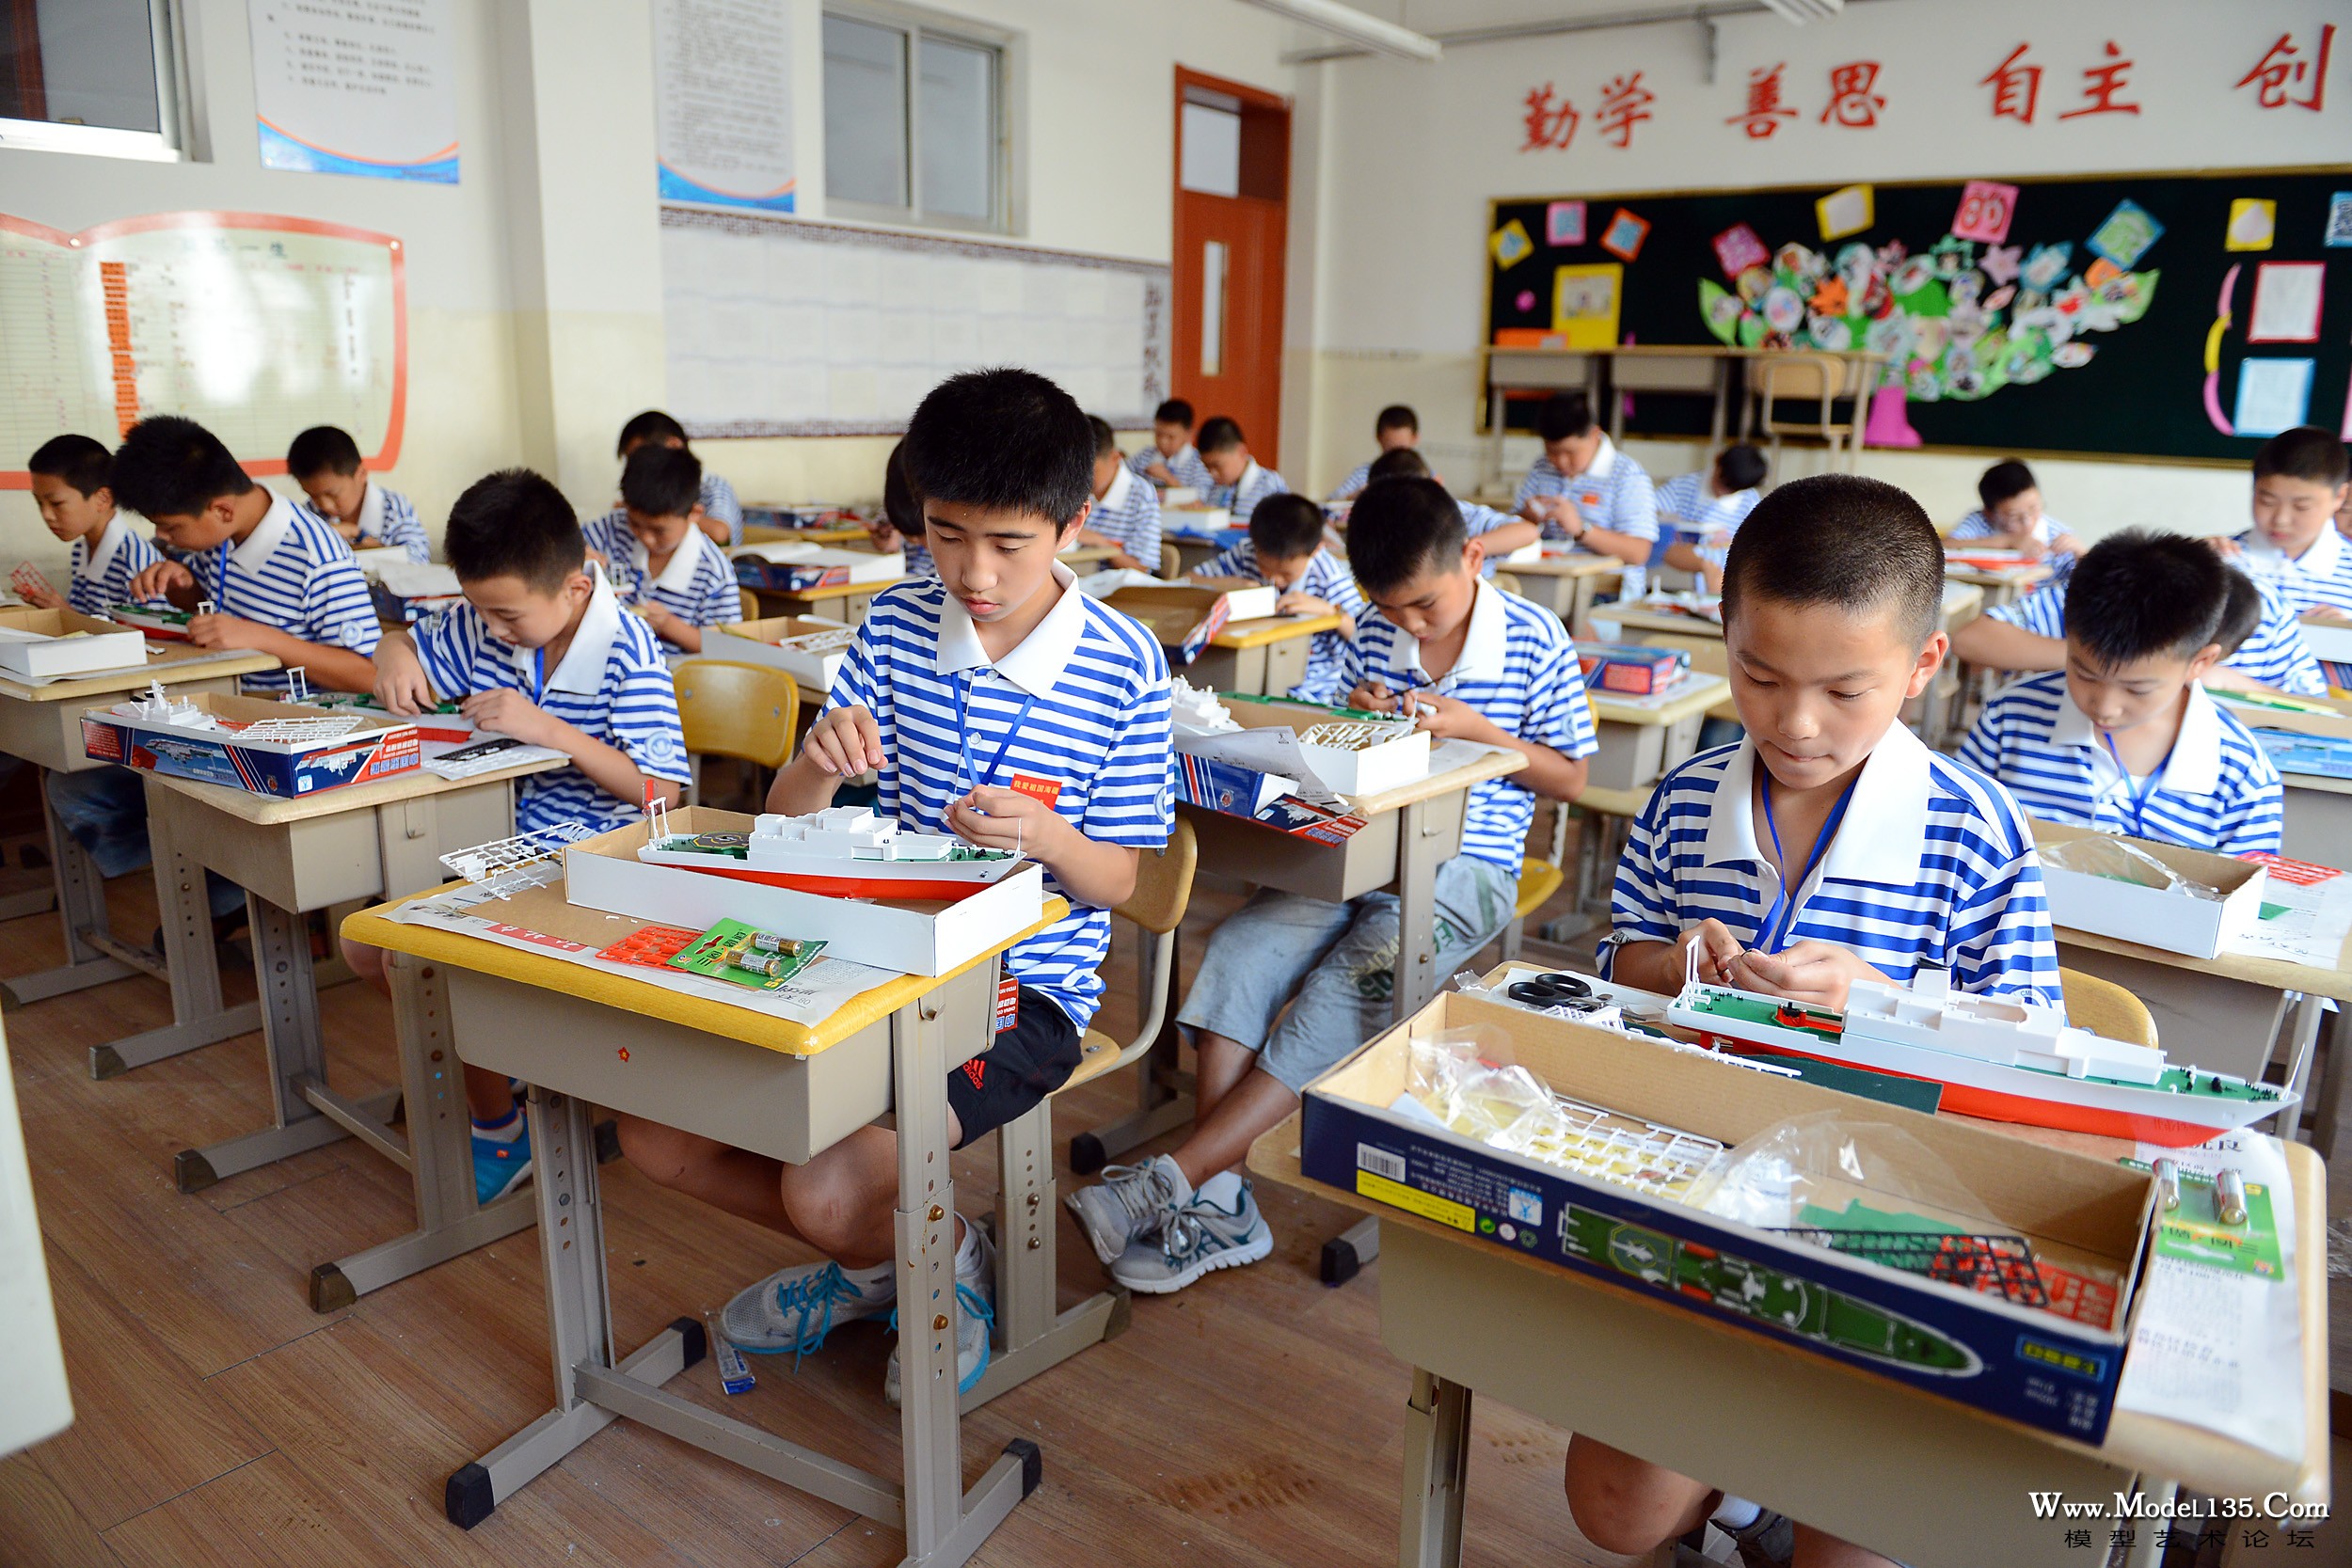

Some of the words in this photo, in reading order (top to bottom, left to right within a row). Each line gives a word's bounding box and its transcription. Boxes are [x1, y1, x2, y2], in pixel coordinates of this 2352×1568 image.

[1519, 71, 1656, 153] 勤学
[1726, 61, 1887, 140] 善思
[1982, 42, 2140, 126] 自主
[2236, 24, 2336, 112] 创
[962, 1064, 984, 1089] didas
